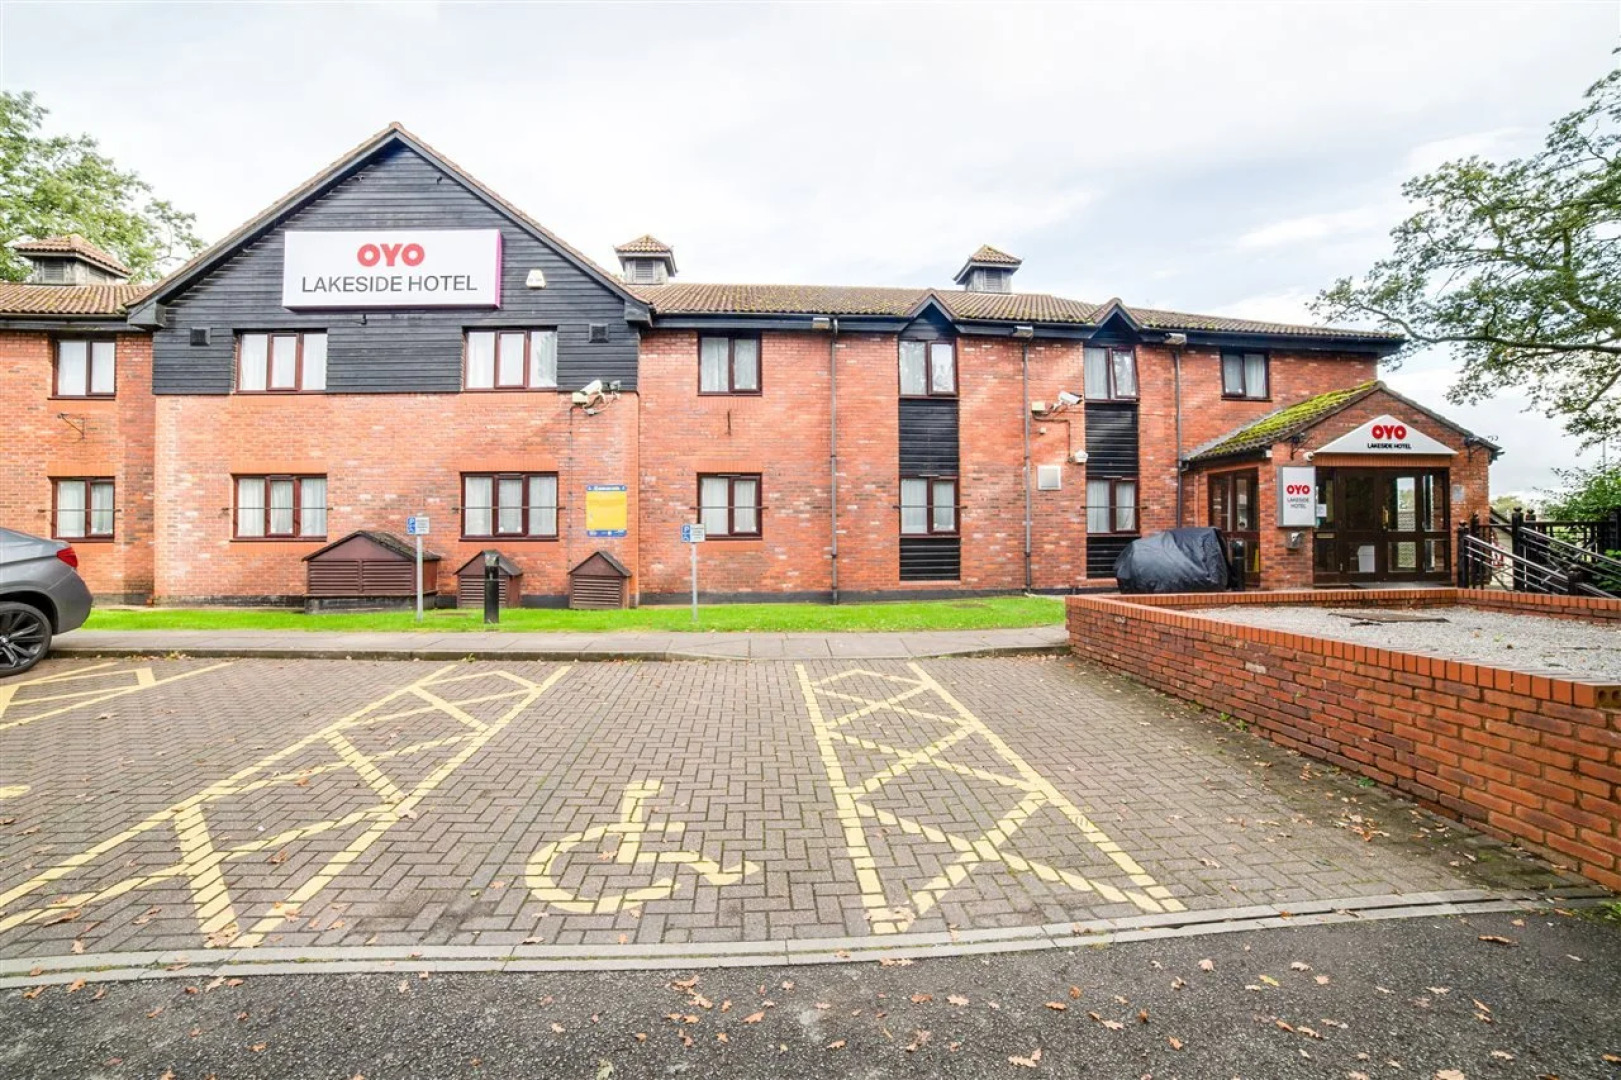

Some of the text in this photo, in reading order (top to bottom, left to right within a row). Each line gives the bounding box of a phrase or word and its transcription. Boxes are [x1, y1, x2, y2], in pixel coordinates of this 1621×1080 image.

[357, 243, 425, 267] OYO
[302, 275, 478, 293] LAKESIDE HOTEL
[1371, 424, 1407, 440] OYO
[1286, 484, 1310, 495] OYO
